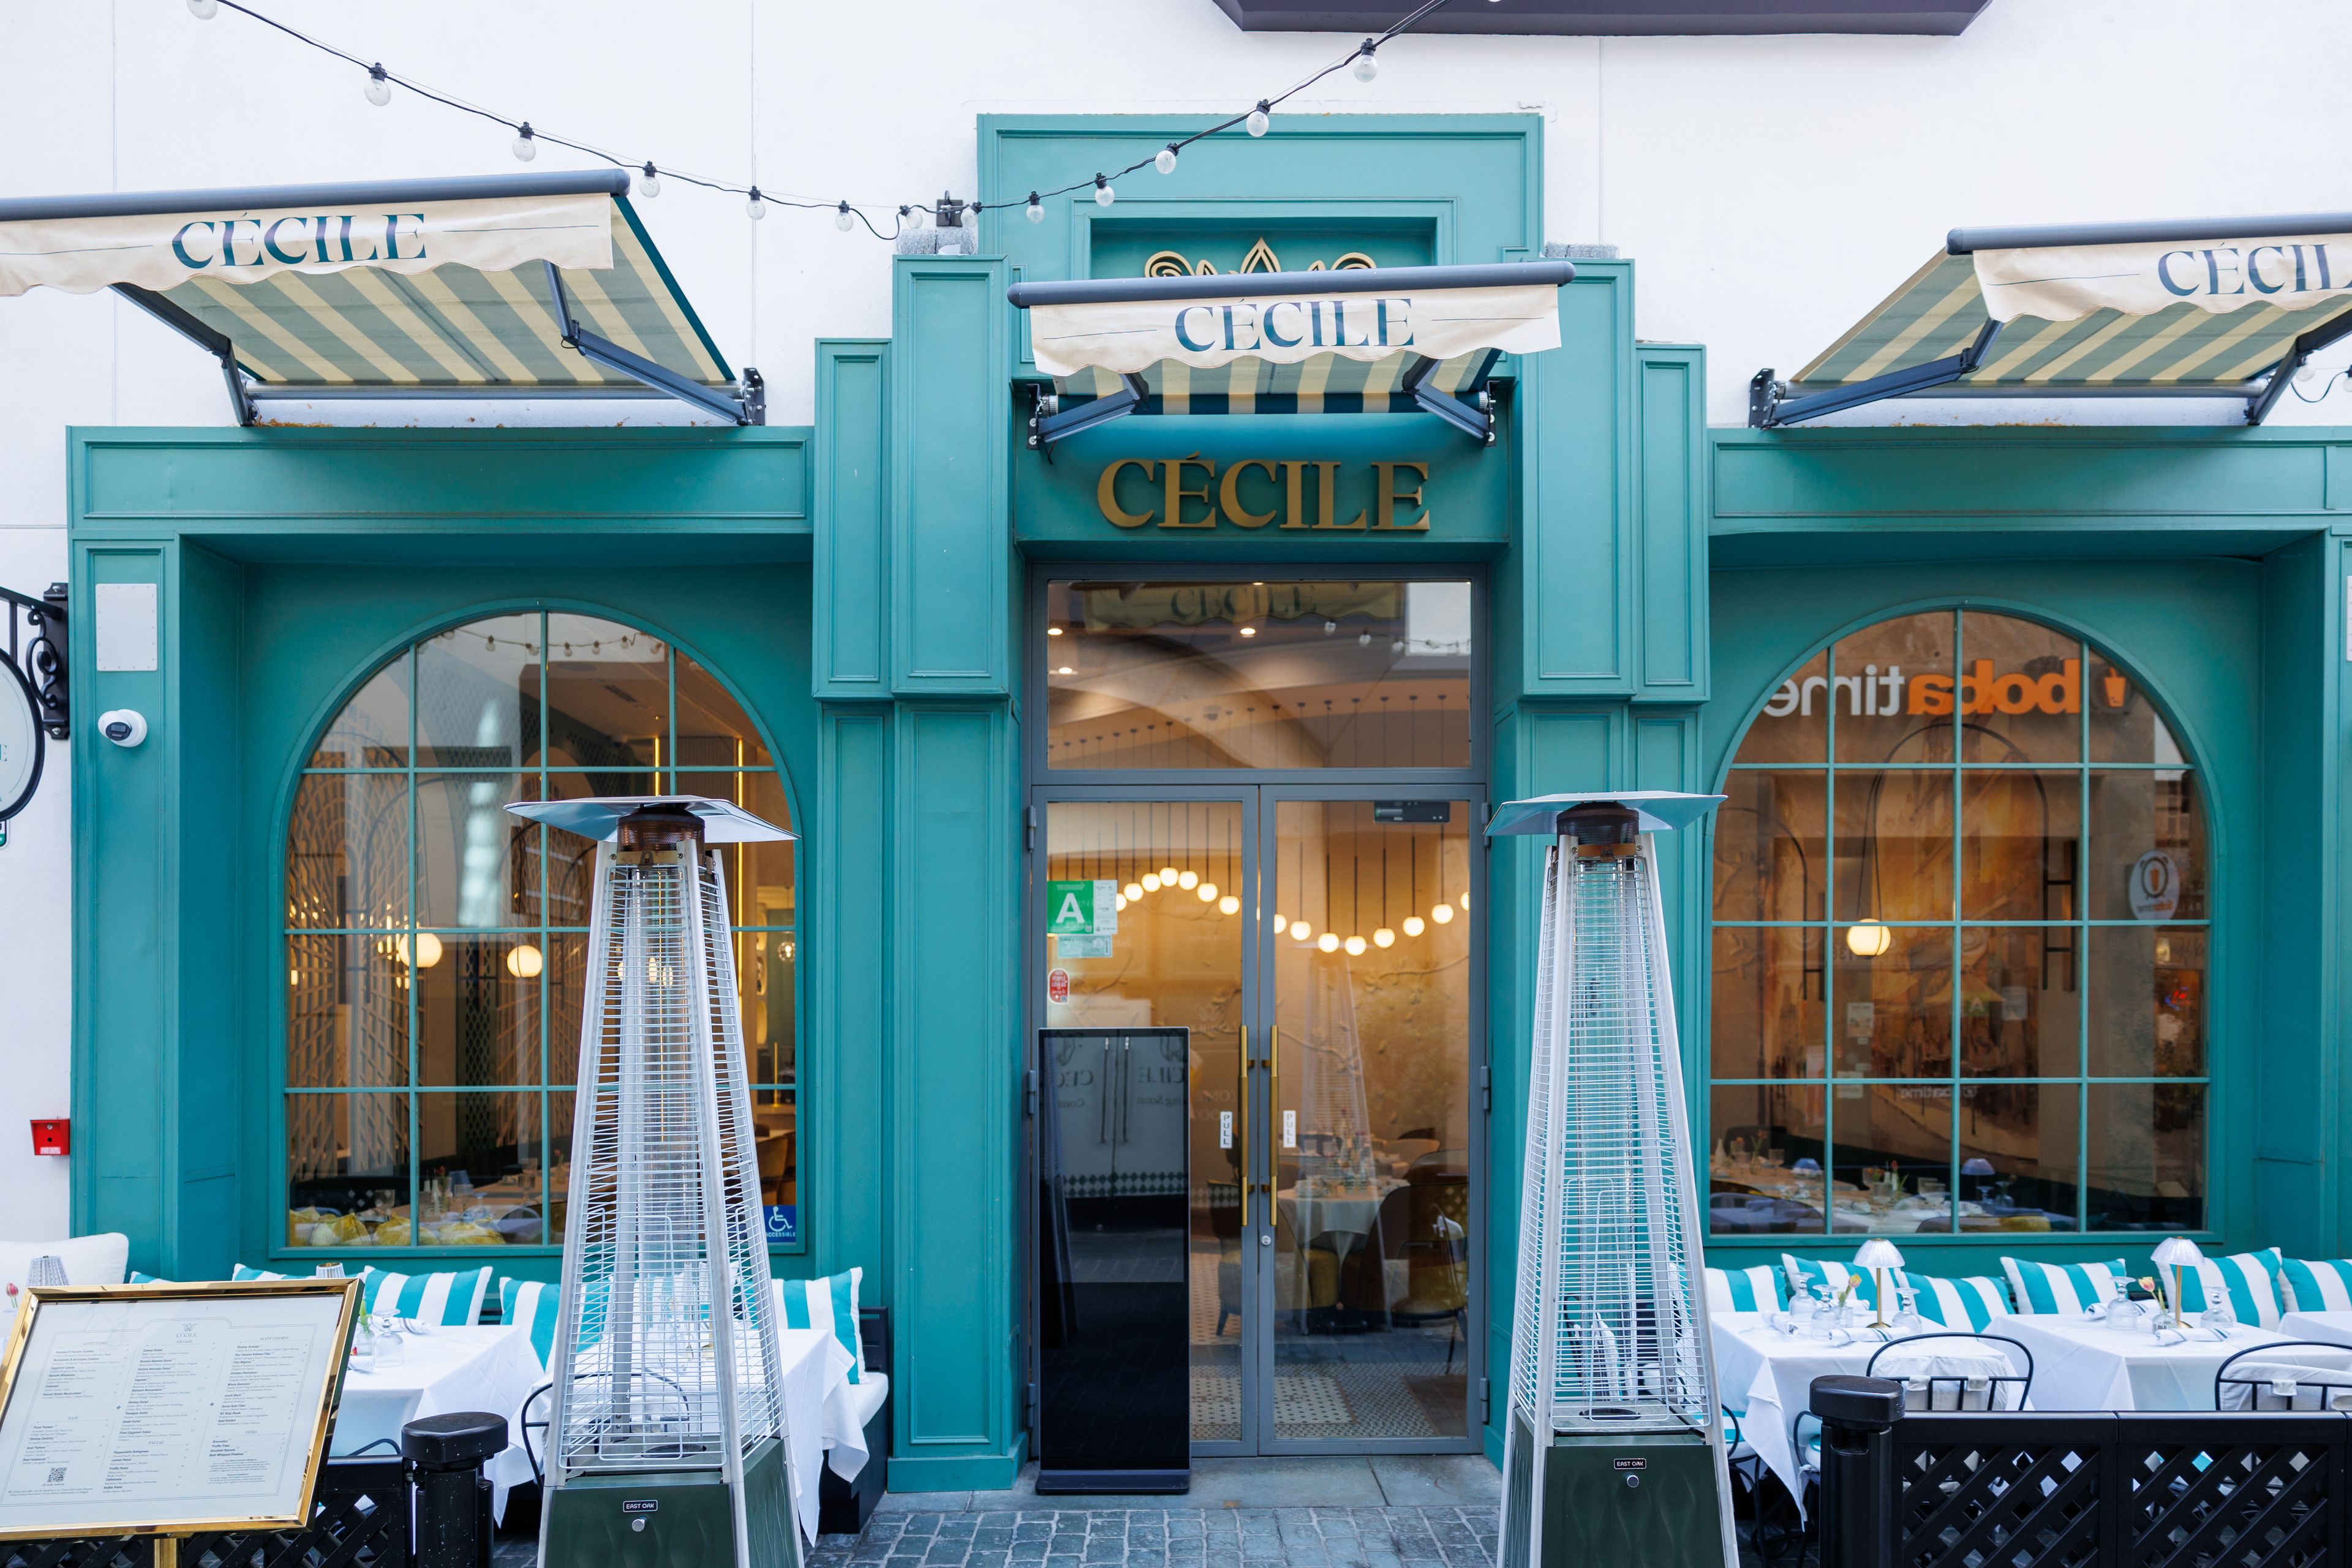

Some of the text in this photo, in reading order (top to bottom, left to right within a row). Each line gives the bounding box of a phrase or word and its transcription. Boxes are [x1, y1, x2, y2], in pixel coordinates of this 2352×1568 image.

[172, 212, 427, 269] CÉCILE
[1175, 298, 1414, 352] CÉCILE
[1097, 451, 1431, 531] CÉCILE
[1055, 892, 1085, 924] A
